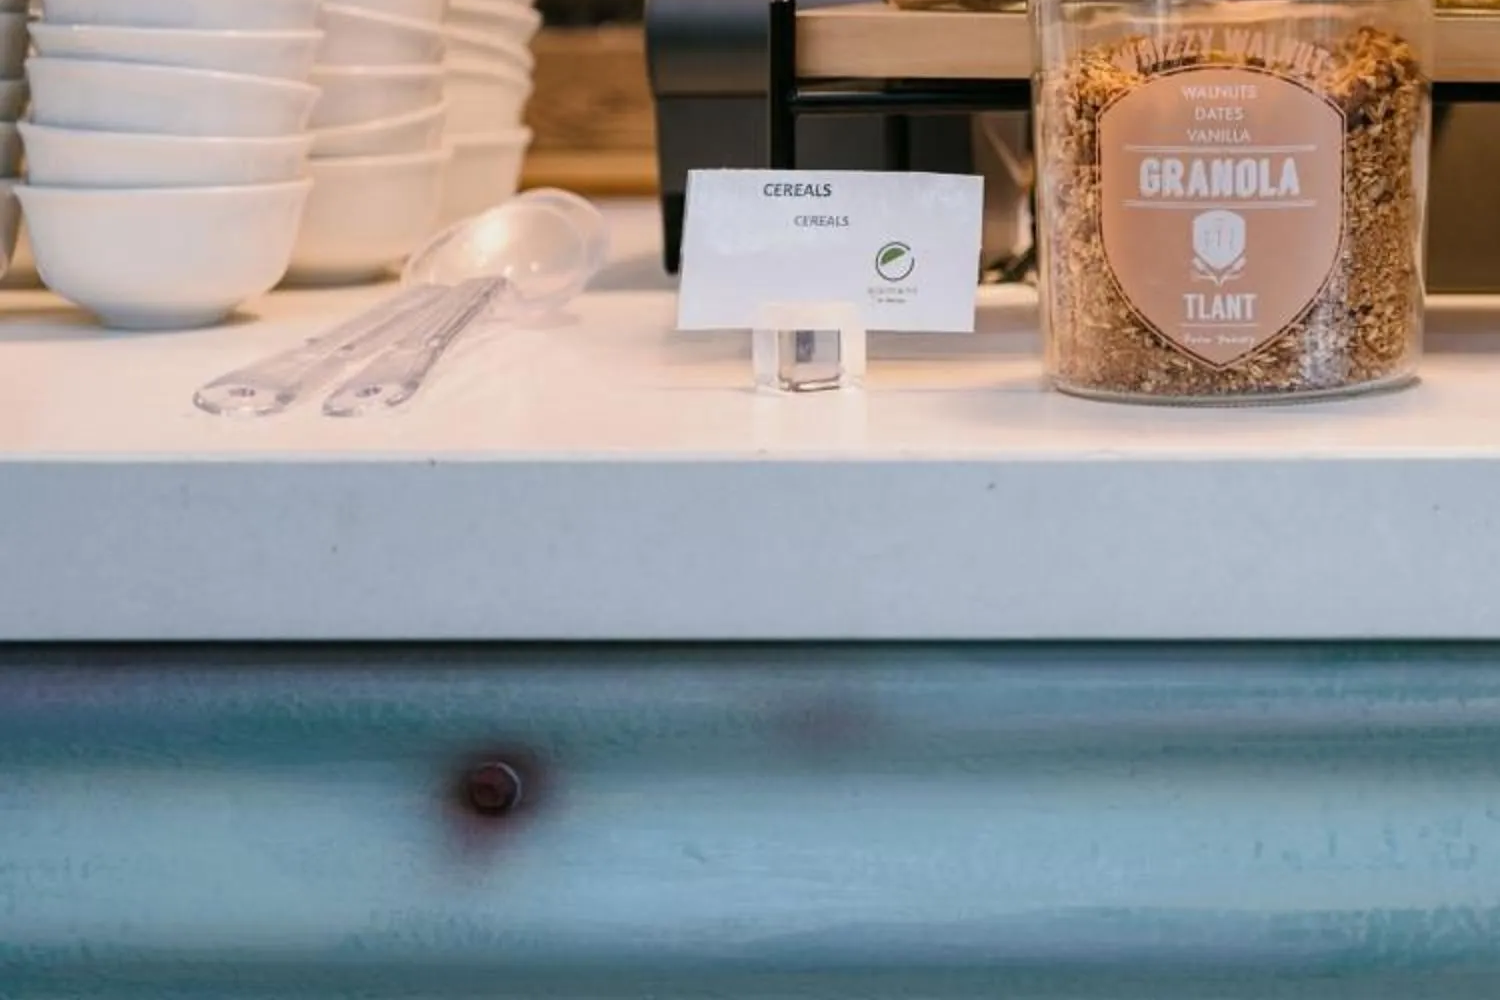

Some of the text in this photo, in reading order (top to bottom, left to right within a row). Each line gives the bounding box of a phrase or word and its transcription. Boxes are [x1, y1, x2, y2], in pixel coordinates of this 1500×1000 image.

[1181, 84, 1258, 100] WALNUTS
[1194, 105, 1245, 121] DATES
[1186, 127, 1252, 143] VANILLA
[1138, 157, 1301, 198] GRANOLA
[762, 182, 833, 198] CEREALS
[793, 214, 850, 228] CEREALS
[1182, 293, 1258, 320] TLANT
